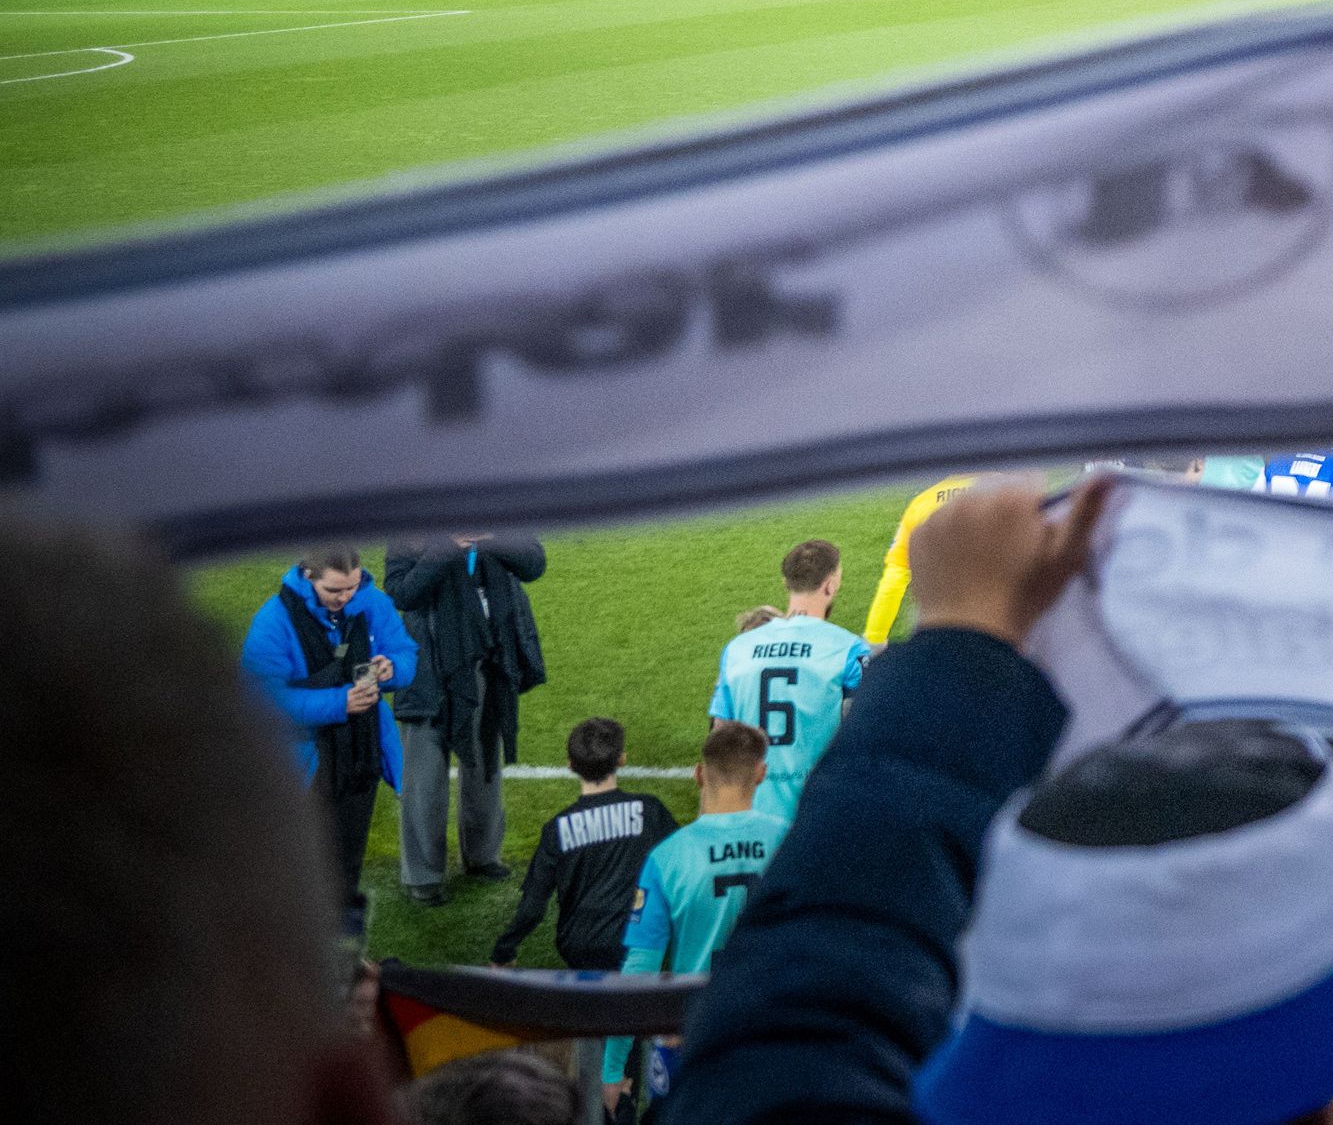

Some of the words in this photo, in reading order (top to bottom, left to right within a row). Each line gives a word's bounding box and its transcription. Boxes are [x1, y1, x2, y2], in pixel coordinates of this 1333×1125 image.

[752, 641, 812, 659] RIEDER
[759, 665, 800, 747] 6
[556, 799, 645, 853] ARMINIS
[709, 840, 765, 864] LANG
